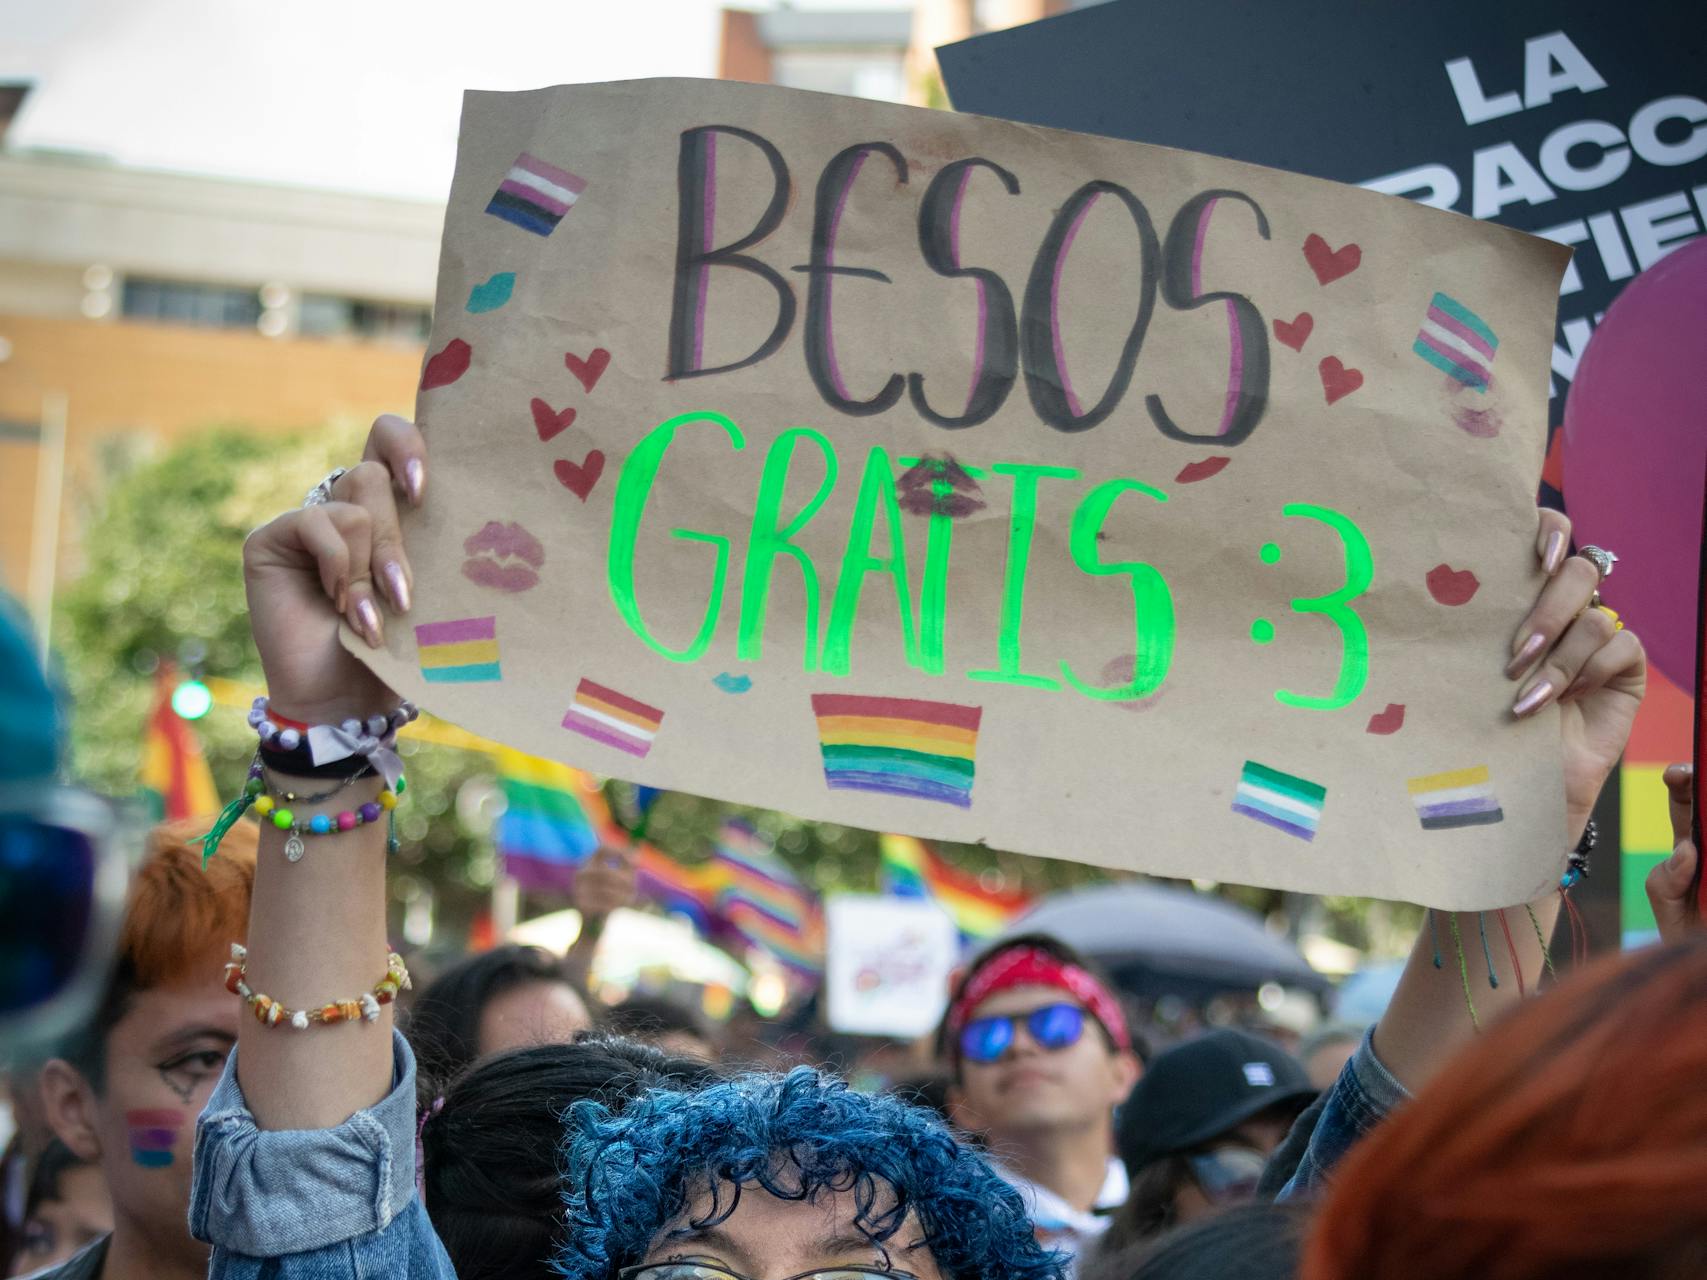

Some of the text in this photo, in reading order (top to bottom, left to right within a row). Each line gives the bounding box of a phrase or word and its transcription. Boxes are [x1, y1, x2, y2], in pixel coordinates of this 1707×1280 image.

[1444, 30, 1608, 126] LA
[661, 124, 1272, 448] BESOS
[607, 410, 1375, 710] GRATIS :3
